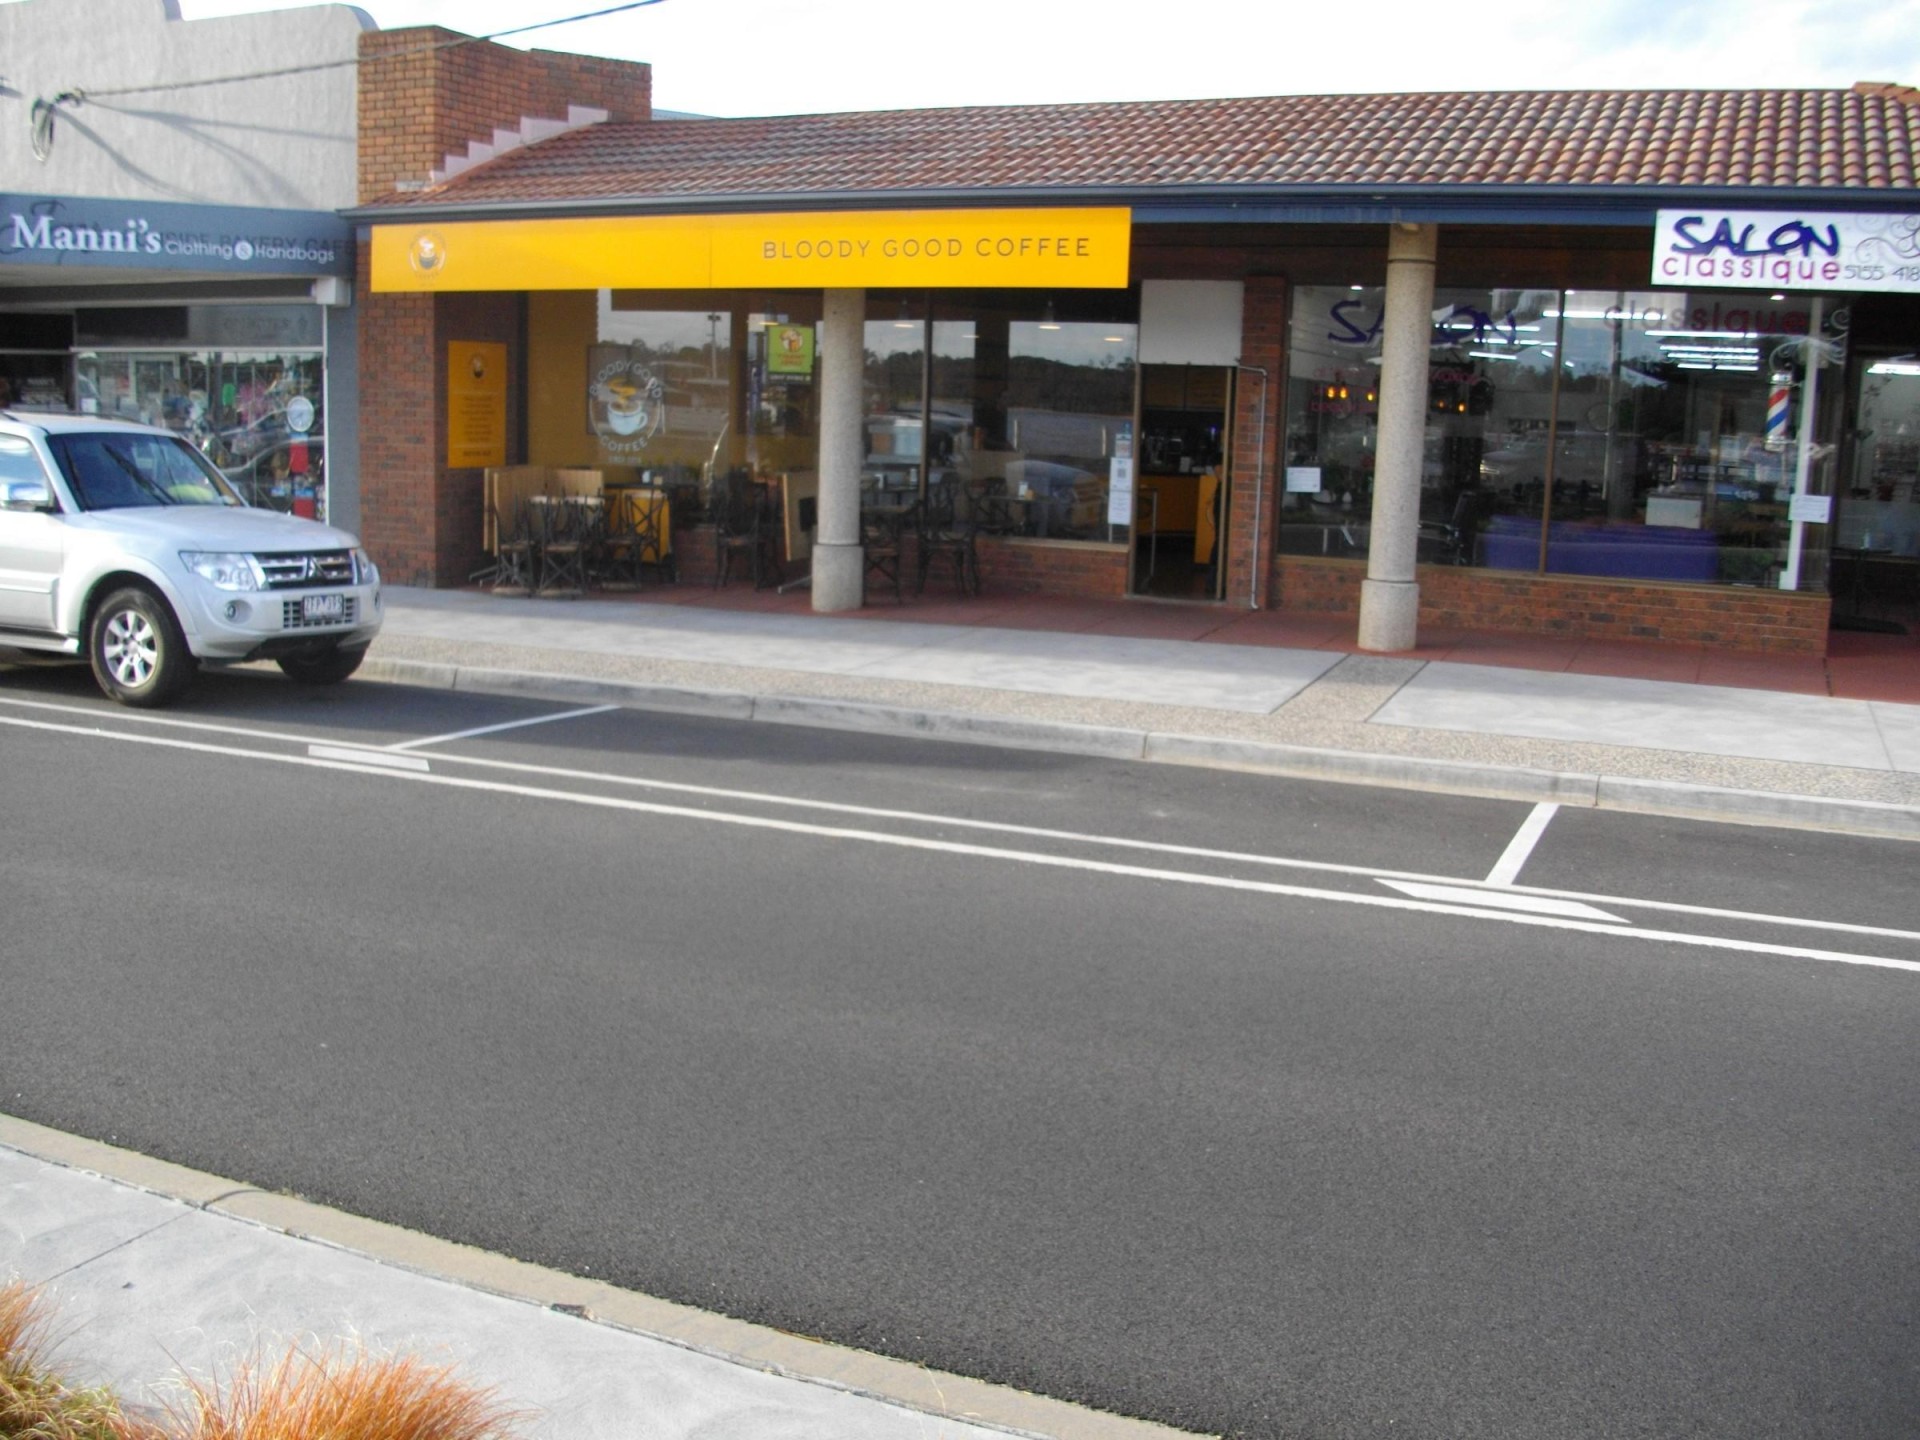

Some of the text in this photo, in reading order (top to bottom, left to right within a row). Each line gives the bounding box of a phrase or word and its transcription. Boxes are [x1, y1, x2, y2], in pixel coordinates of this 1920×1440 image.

[10, 214, 161, 254] Manni's
[165, 240, 233, 260] Clothing
[255, 244, 335, 264] Handbags
[763, 237, 1091, 259] BLOODY GOOD COFFEE
[1671, 216, 1840, 257] SALON
[1662, 254, 1841, 285] classique
